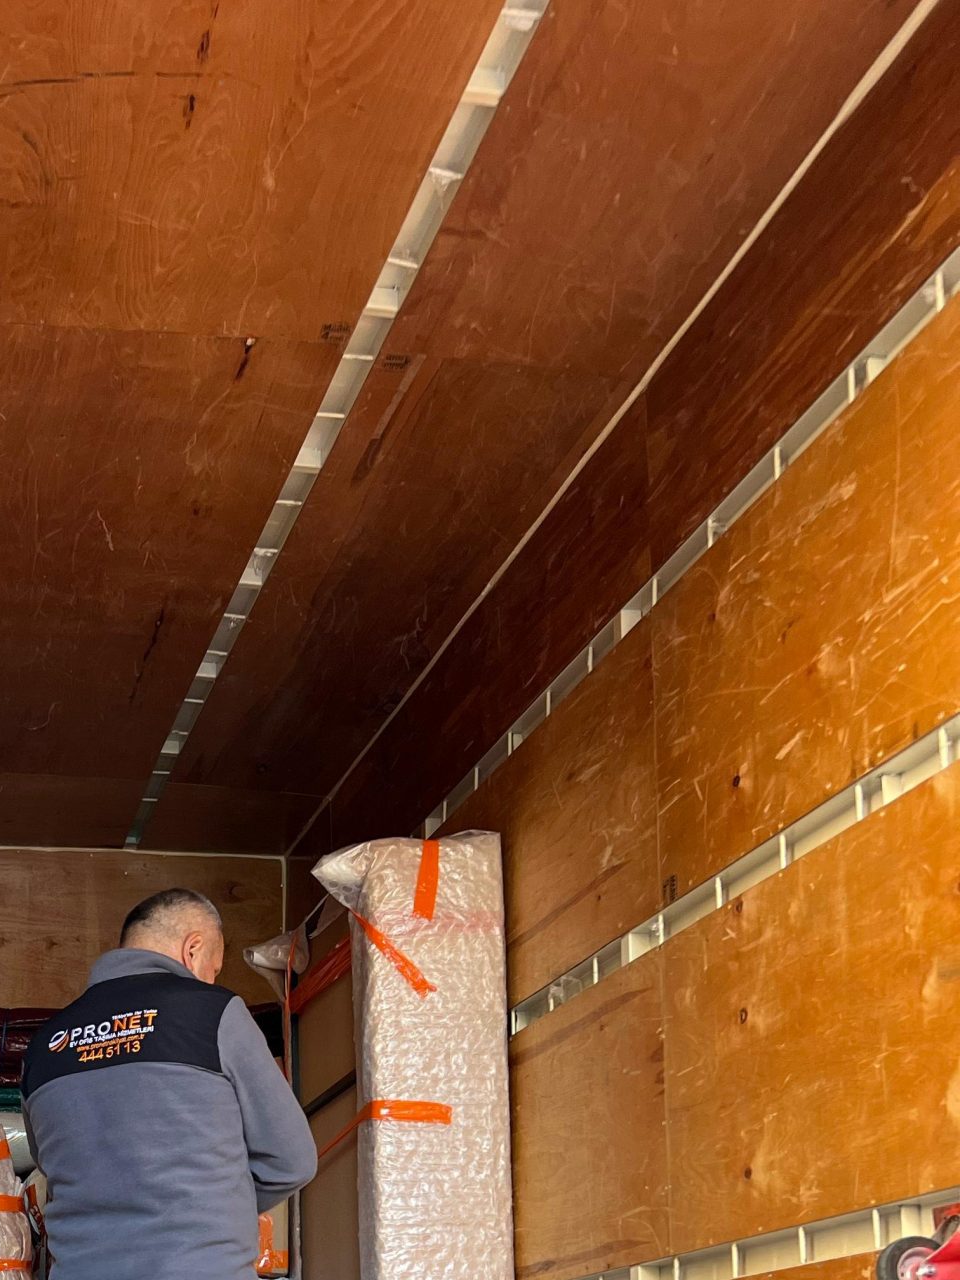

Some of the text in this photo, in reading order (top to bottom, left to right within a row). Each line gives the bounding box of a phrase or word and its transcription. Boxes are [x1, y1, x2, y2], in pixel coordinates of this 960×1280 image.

[71, 1013, 157, 1041] PRONET
[79, 1040, 141, 1062] 444 51 13
